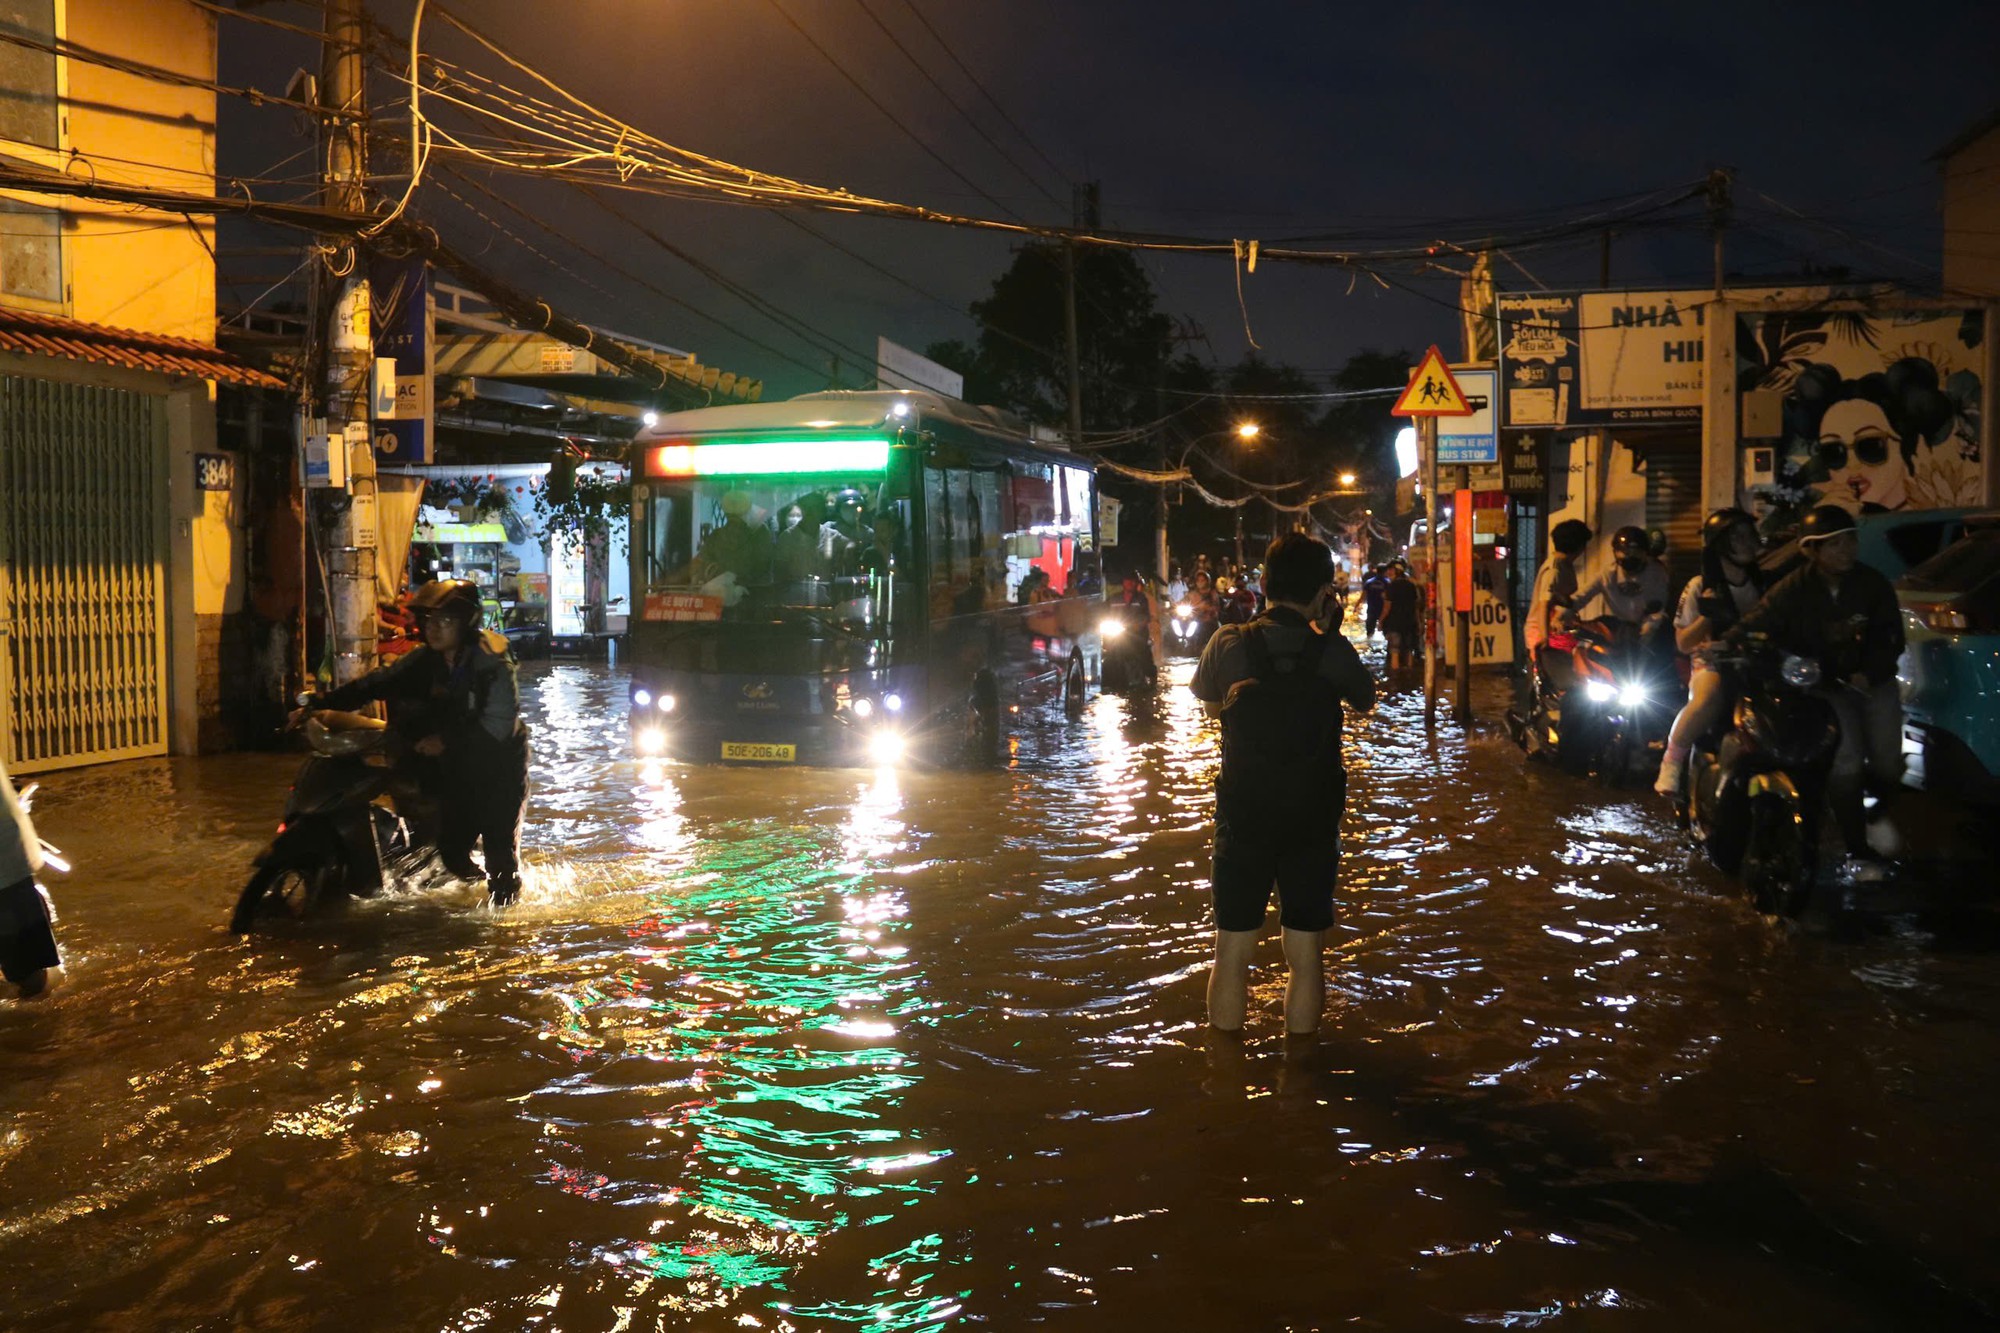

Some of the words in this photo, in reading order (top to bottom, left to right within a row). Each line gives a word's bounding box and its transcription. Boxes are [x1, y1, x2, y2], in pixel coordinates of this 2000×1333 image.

[1612, 298, 1682, 328] NHÀ
[1438, 450, 1459, 459] BUS
[1461, 449, 1488, 459] STOP
[1514, 452, 1538, 468] NHÀ
[199, 458, 229, 485] 384
[1508, 470, 1544, 489] THUỐC
[727, 745, 790, 758] 50E-206.48
